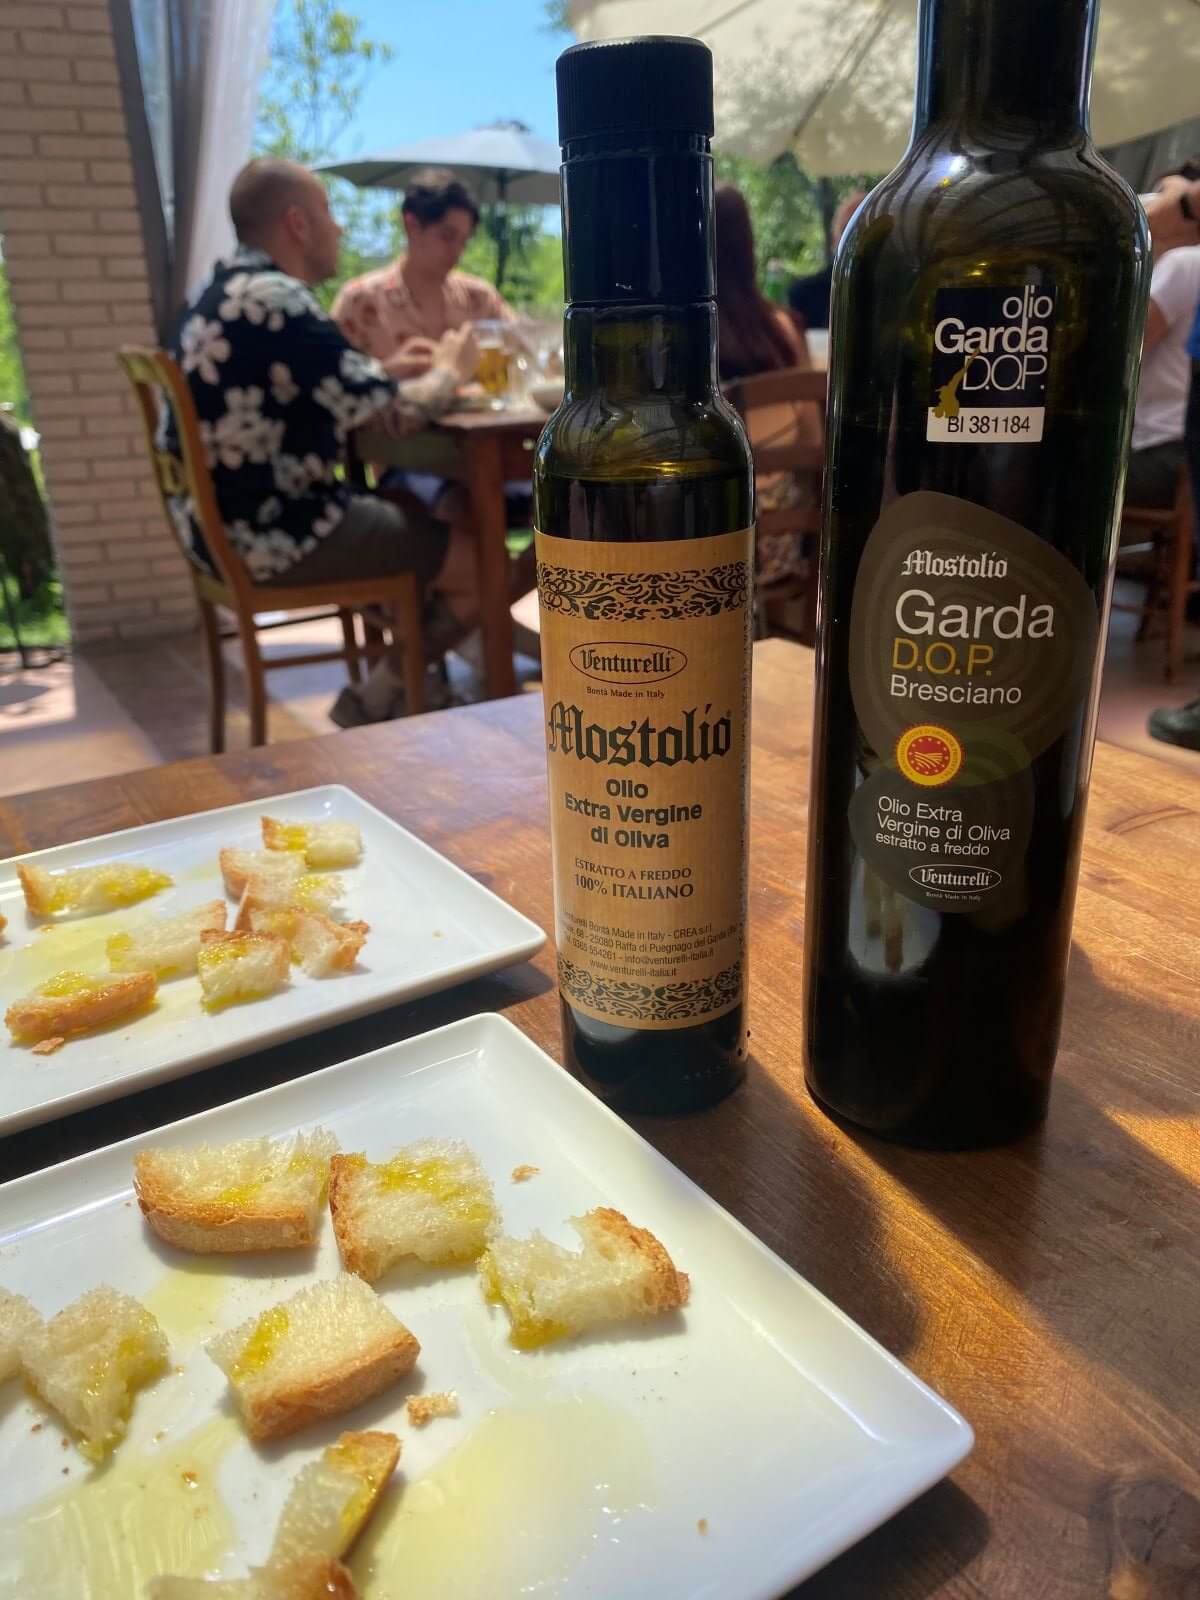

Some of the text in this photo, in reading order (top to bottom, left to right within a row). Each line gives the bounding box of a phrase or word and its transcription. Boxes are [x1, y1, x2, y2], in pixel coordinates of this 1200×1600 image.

[1001, 285, 1053, 318] olio
[934, 317, 1049, 353] Garda
[962, 354, 1048, 391] D.O.P.
[947, 416, 1031, 434] BI 381184
[901, 550, 1008, 578] Mostolio
[895, 589, 1055, 639] Garda
[579, 649, 671, 673] Venturelli
[892, 637, 994, 676] D.O.P.
[611, 689, 632, 698] Made
[646, 690, 665, 699] Italy
[890, 674, 1022, 704] Bresciano
[548, 701, 733, 768] Mostolio
[606, 779, 649, 799] Olio
[564, 792, 703, 826] Extra Vergine
[878, 795, 963, 822] Olio Extra
[590, 826, 670, 848] di Oliva
[876, 813, 1011, 841] Vergine di Oliva
[875, 832, 991, 856] estratto a freddo
[575, 858, 692, 881] ESTRATTO A FREDDO
[920, 868, 990, 886] Venturelli
[575, 874, 694, 900] 100% ITALIANO
[612, 927, 636, 939] Made
[637, 929, 645, 940] in
[647, 931, 666, 942] Italy
